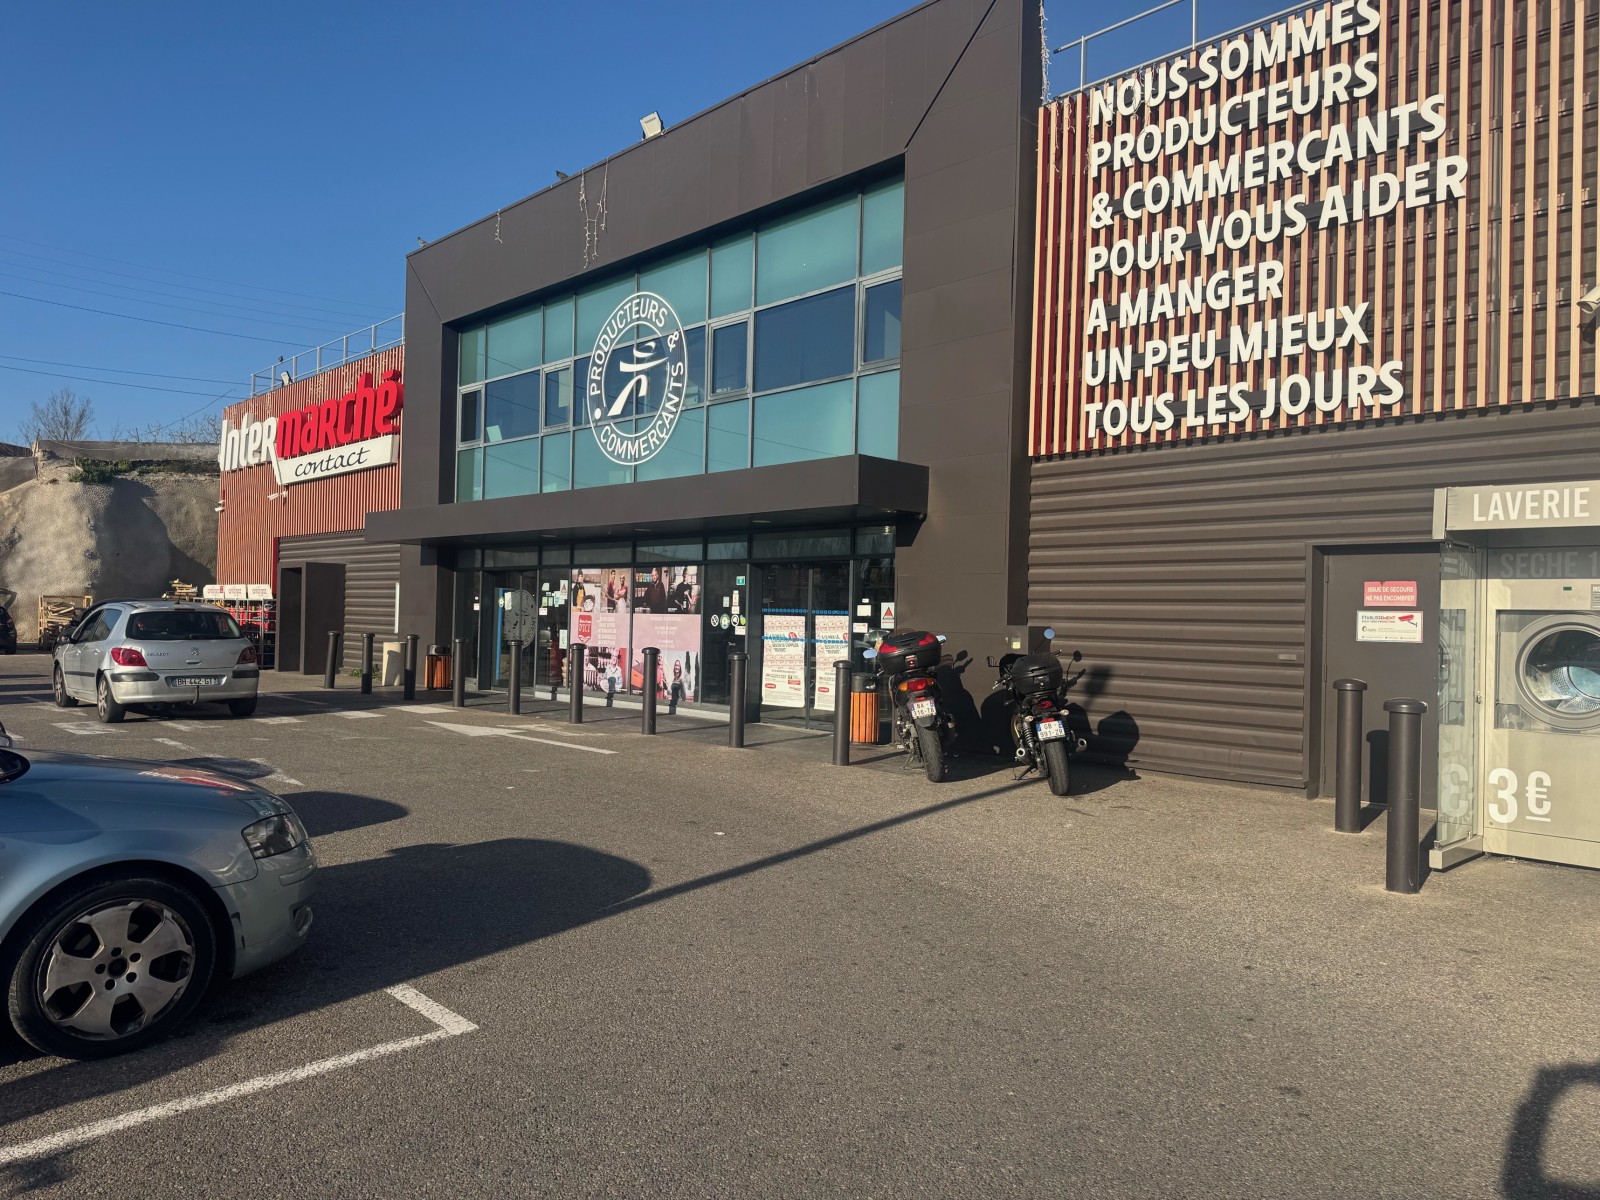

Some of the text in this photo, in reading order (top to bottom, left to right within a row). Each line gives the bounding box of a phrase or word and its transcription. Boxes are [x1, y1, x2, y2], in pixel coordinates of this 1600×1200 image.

[1091, 0, 1382, 127] NOUS SOMMES
[1089, 94, 1448, 230] & COMMERÇANTS
[1090, 52, 1379, 179] PRODUCTEURS
[1087, 154, 1470, 284] POUR VOUS AIDER
[1084, 300, 1371, 388] UN PEU MIEUX
[1085, 259, 1285, 336] A MANGER
[590, 297, 668, 396] PRODUCTEURS
[599, 361, 685, 461] COMMERÇANTS
[1083, 359, 1405, 440] TOUS LES JOURS
[294, 446, 371, 478] contact
[1472, 486, 1590, 522] LAVERIE
[1500, 551, 1579, 579] SECHE
